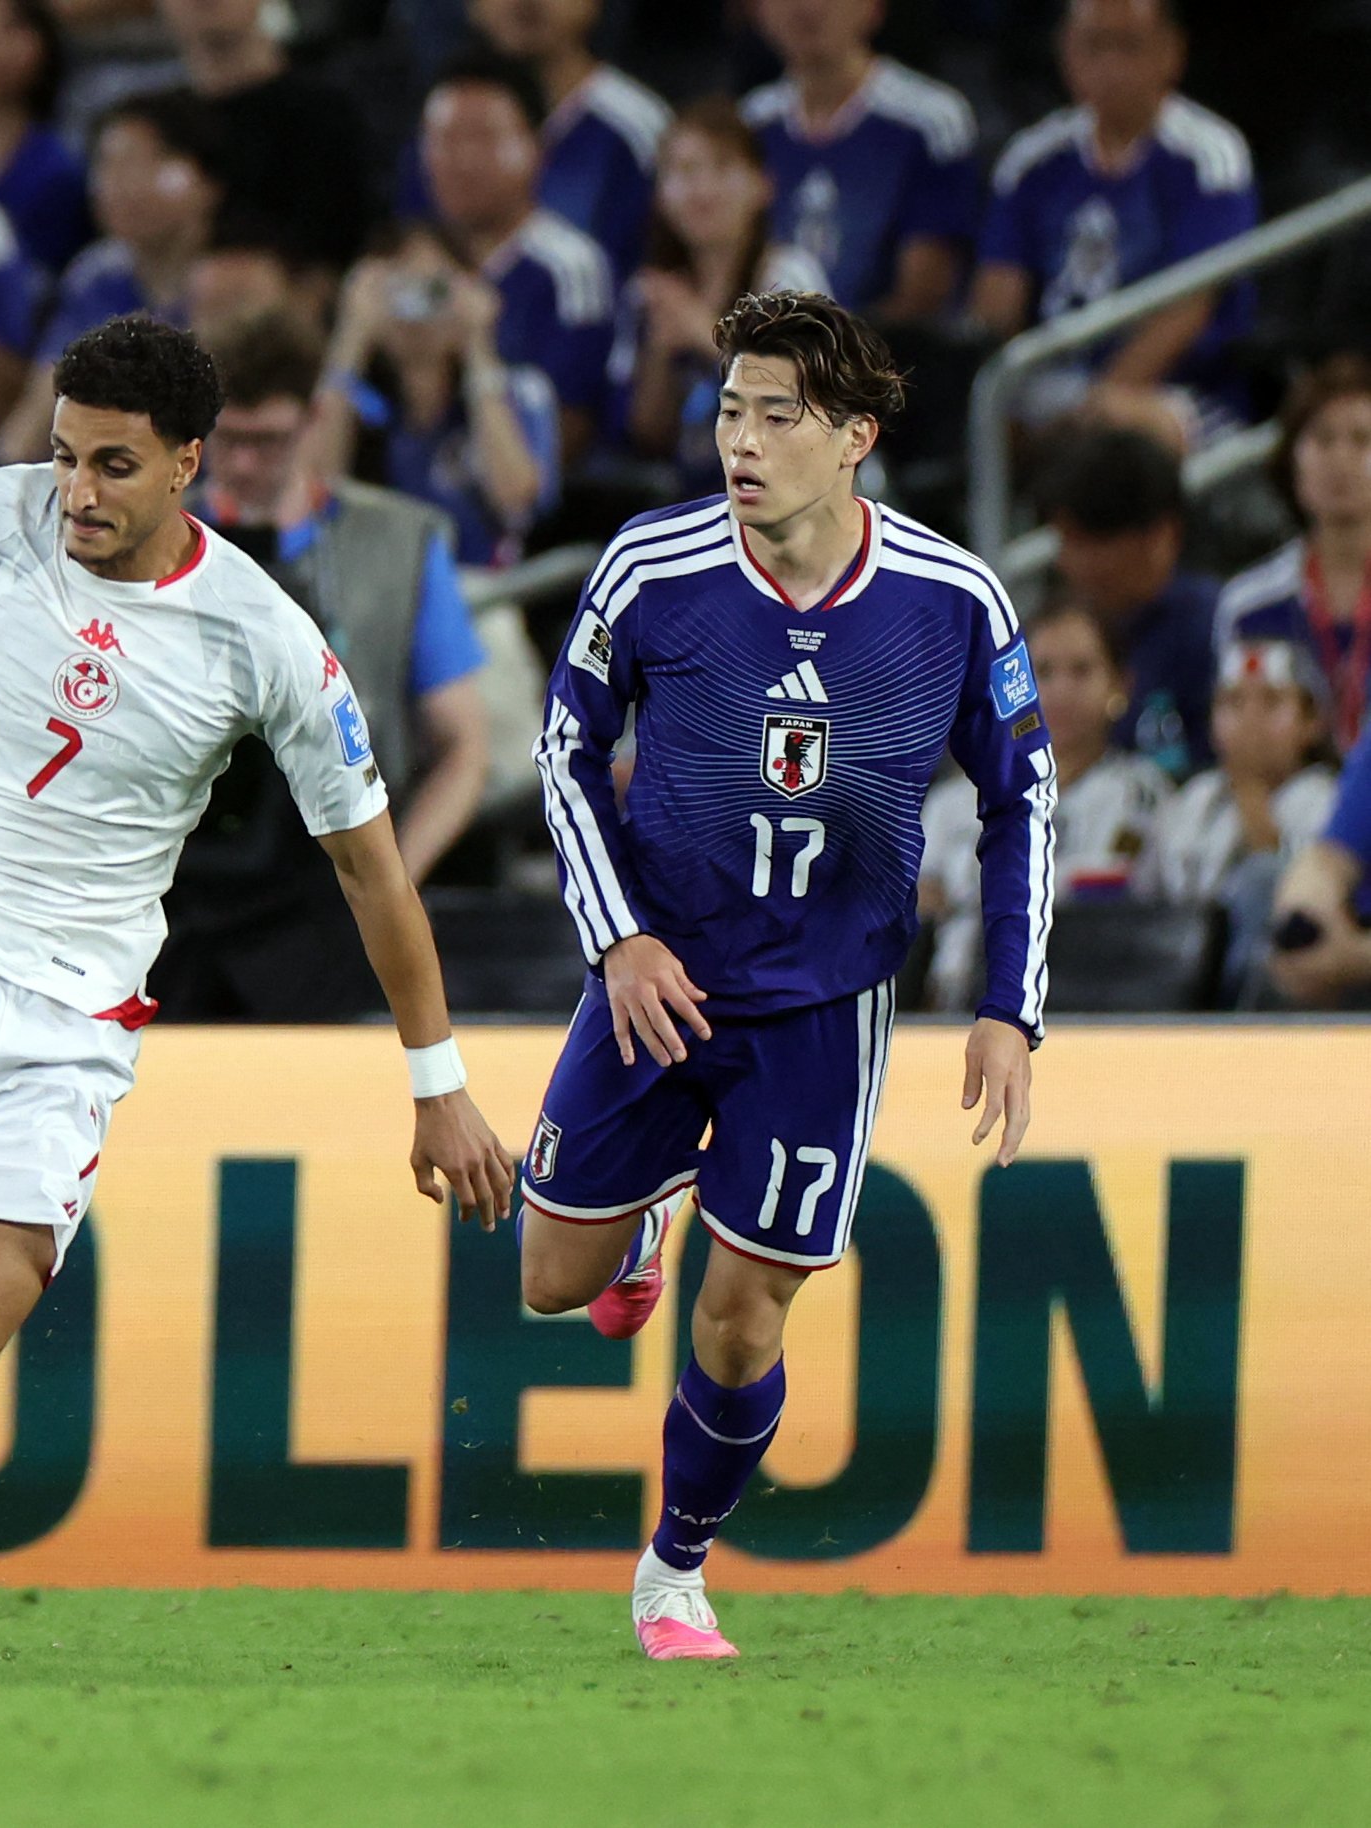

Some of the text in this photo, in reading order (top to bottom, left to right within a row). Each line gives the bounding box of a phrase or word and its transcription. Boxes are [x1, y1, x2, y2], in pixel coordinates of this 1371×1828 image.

[780, 719, 814, 729] JAPAN
[1007, 680, 1030, 703] PEACE
[25, 716, 83, 800] 7
[749, 812, 826, 897] 17
[757, 1136, 837, 1236] 17
[206, 1157, 1247, 1558] LEON
